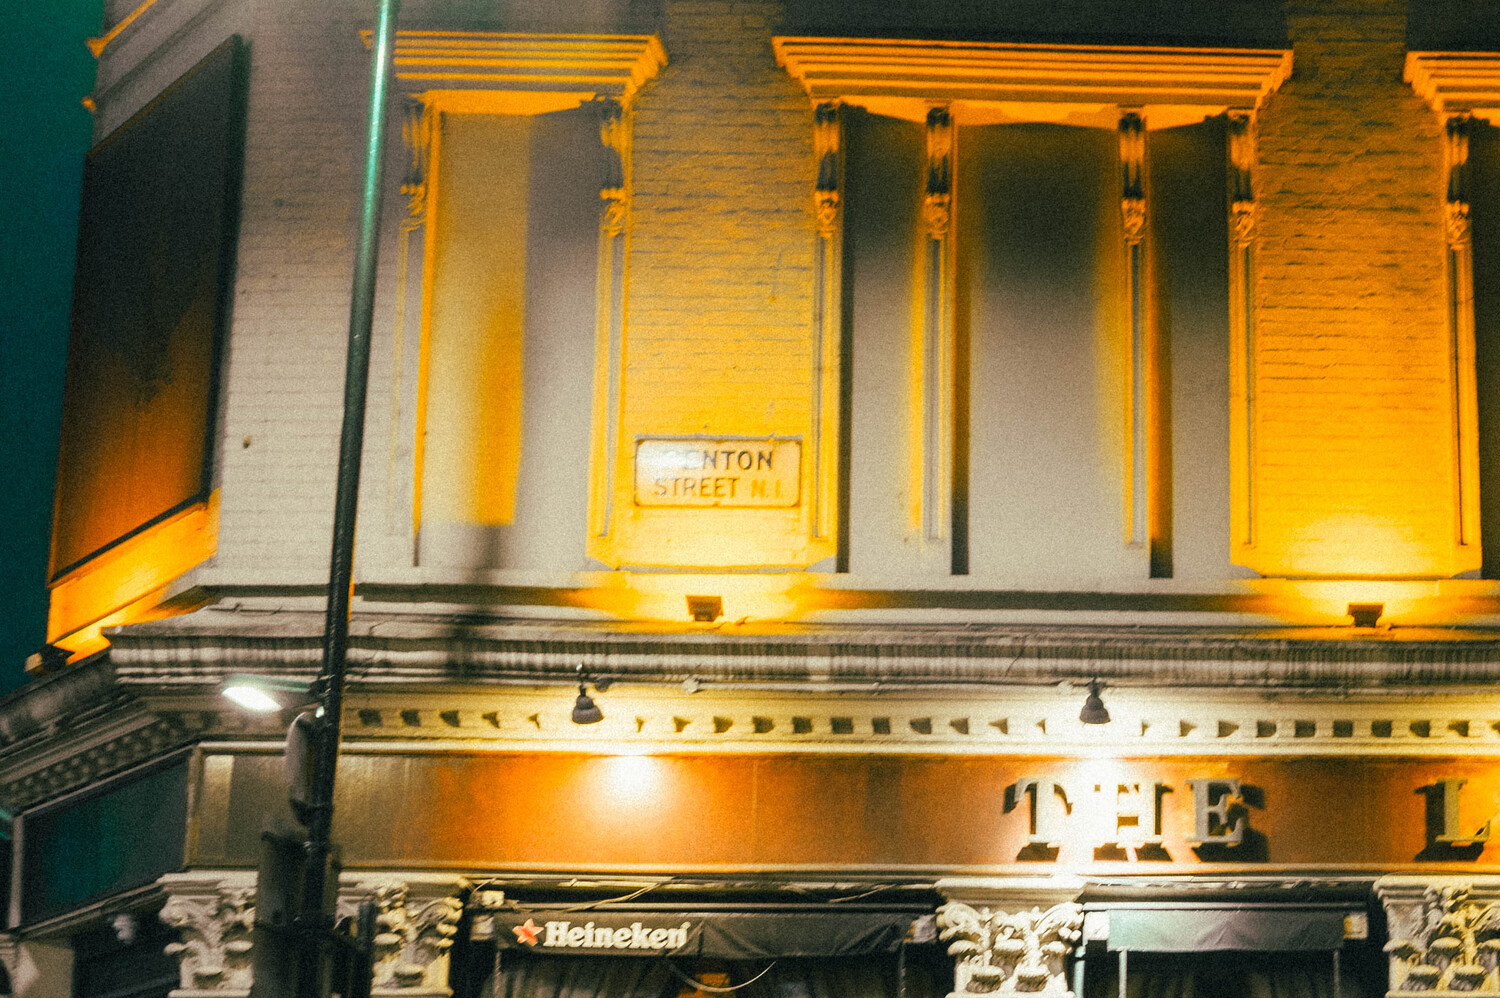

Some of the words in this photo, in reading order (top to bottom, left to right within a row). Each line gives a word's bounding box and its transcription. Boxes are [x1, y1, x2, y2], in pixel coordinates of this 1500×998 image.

[663, 450, 773, 471] ENTON
[653, 476, 740, 498] STREET
[1010, 777, 1250, 846] THE
[543, 920, 692, 950] Heineken
